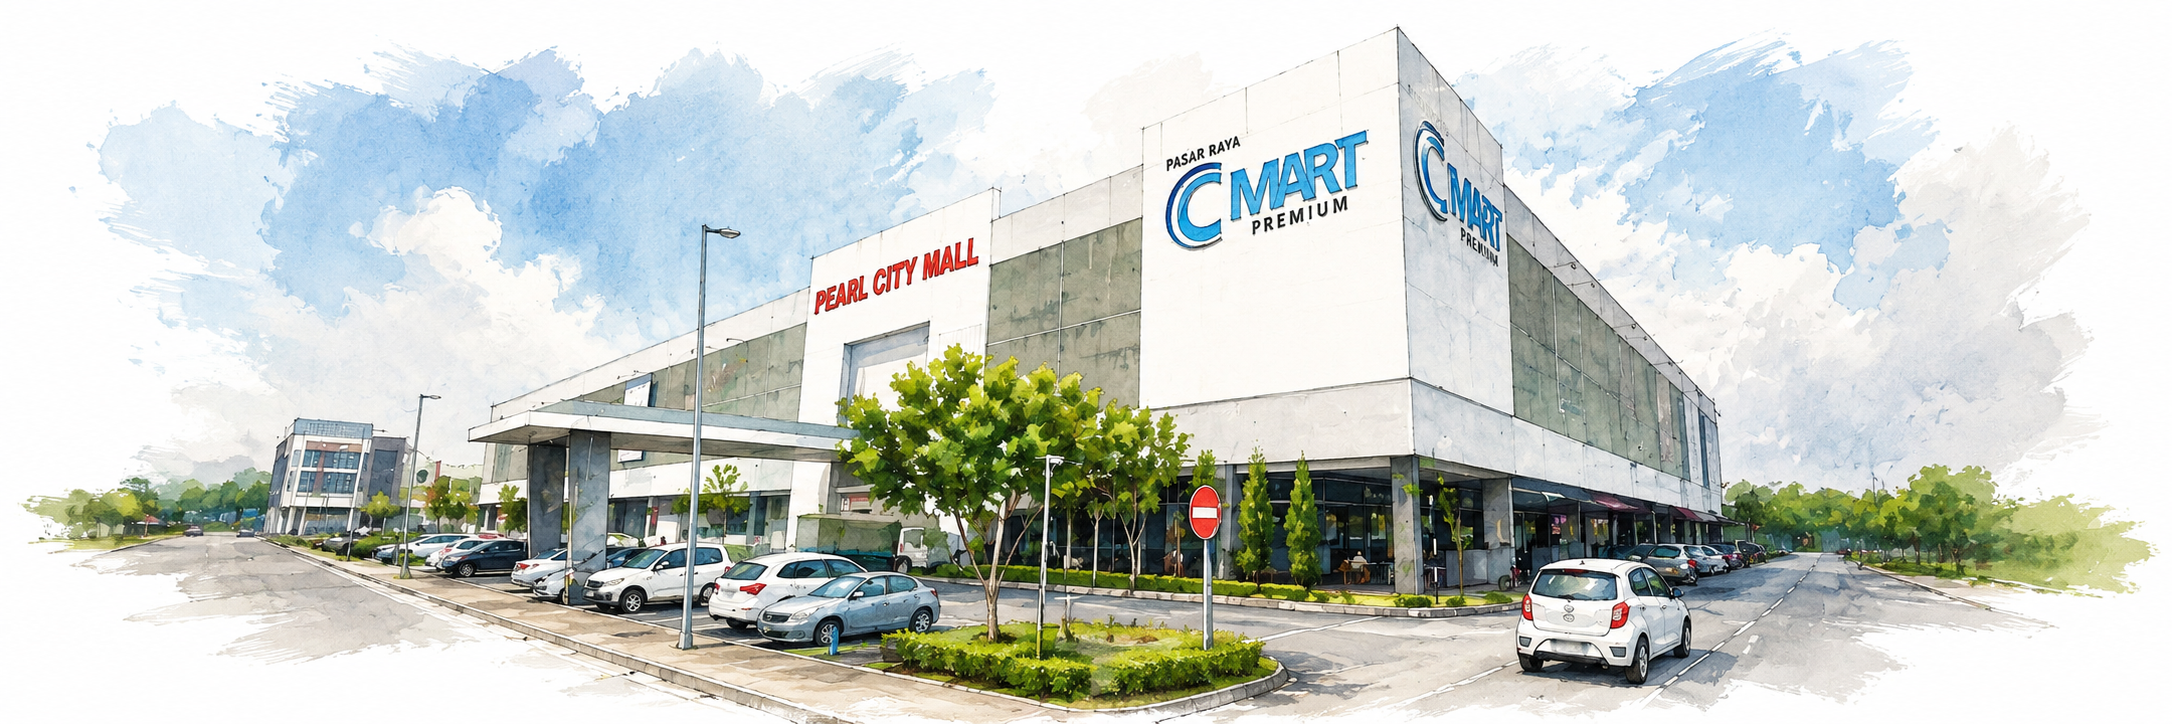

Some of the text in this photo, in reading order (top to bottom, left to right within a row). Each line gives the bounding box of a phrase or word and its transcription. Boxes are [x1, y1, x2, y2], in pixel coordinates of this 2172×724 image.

[1166, 135, 1241, 172] PASAR RAYA
[1252, 196, 1349, 235] PREMIUM
[814, 237, 979, 315] PEARL CITY MALL
